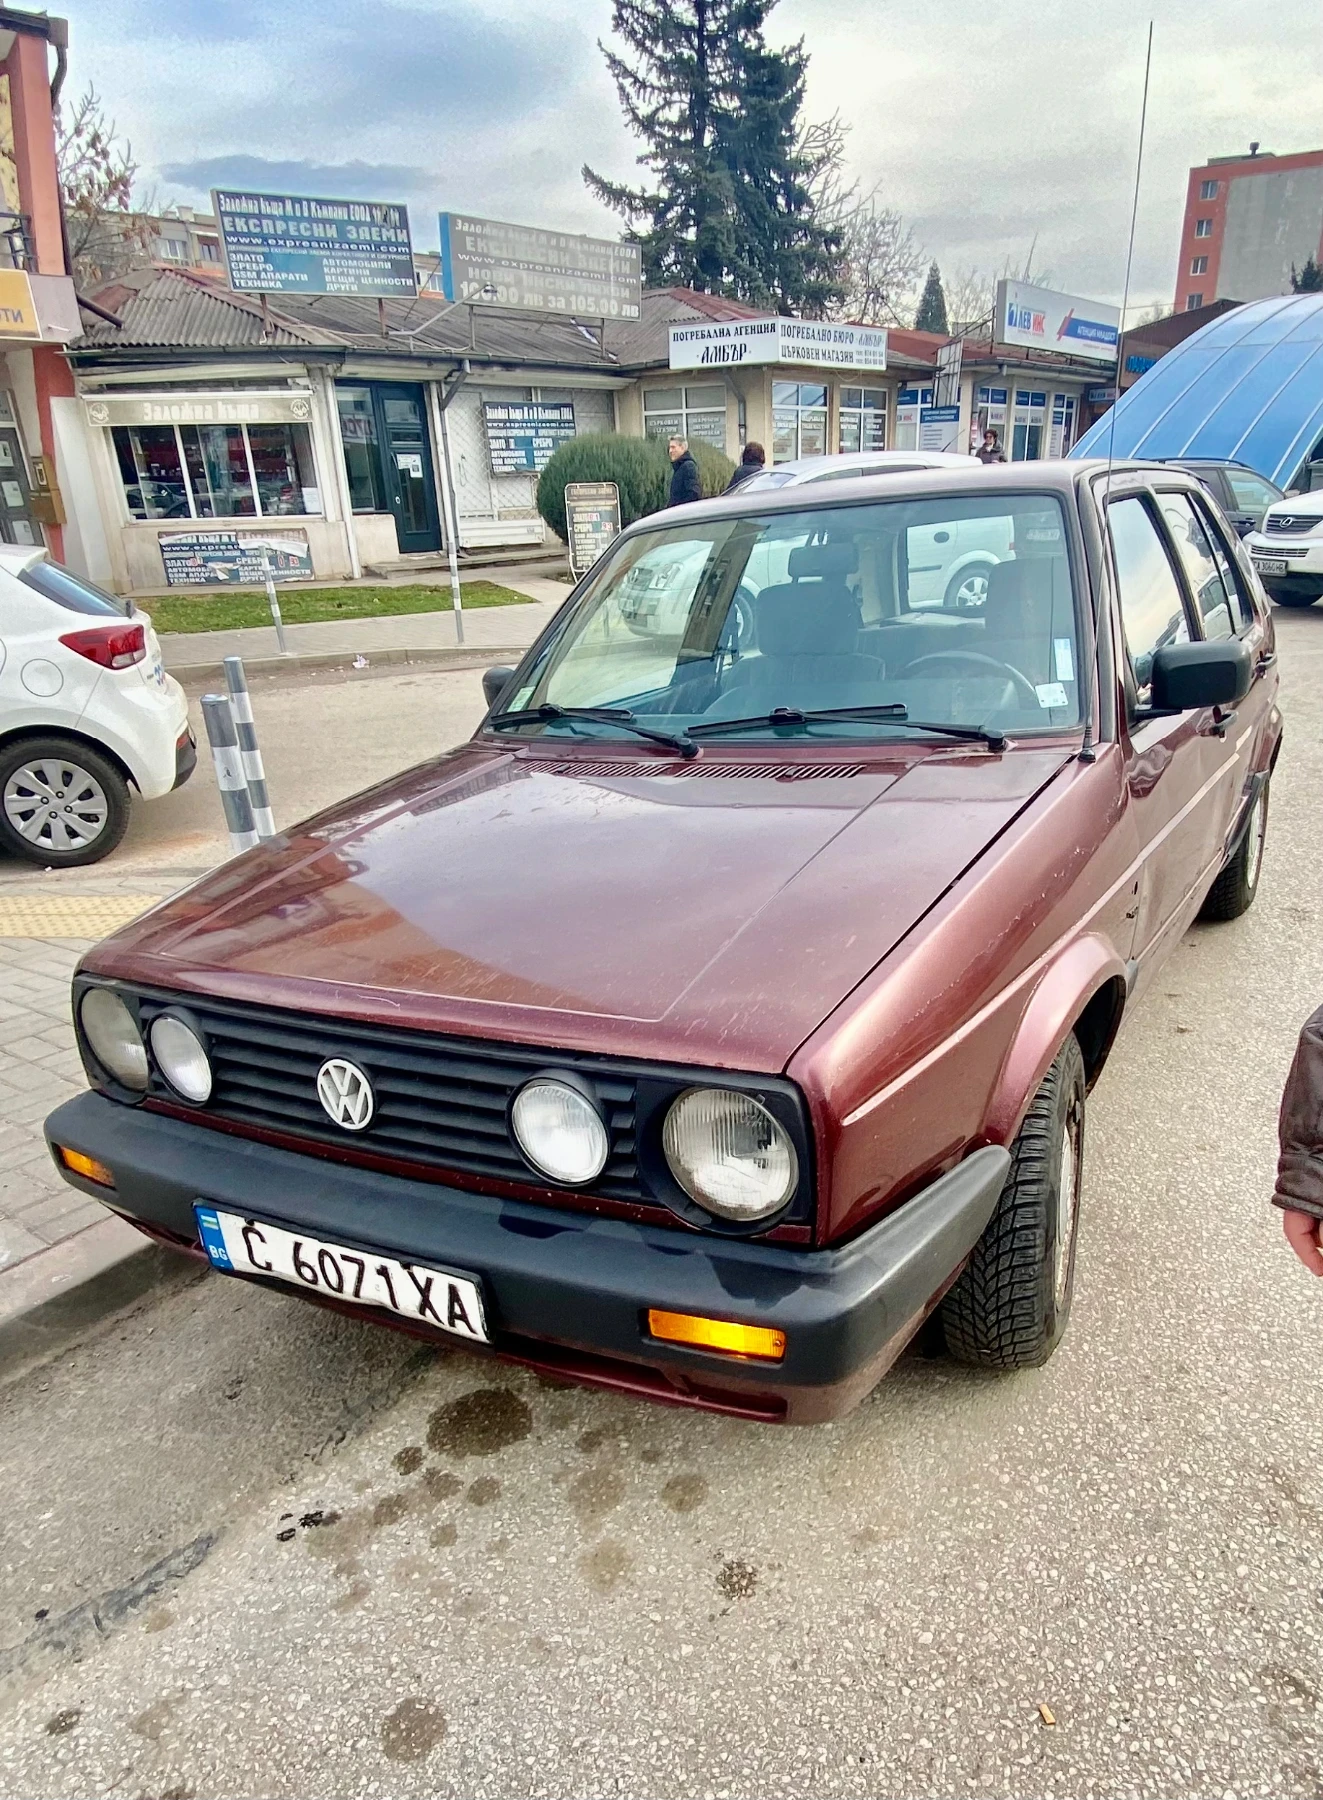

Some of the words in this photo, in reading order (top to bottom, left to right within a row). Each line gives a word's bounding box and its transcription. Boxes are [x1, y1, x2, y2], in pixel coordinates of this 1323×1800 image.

[220, 194, 259, 214] Заложна
[223, 216, 338, 238] ЕКСПРЕСНИ
[346, 225, 409, 242] ЗАЕМИ
[226, 235, 409, 253] www.expresnizaemi.com
[230, 253, 264, 262] ЗЛАТО
[231, 262, 273, 271] СРЕБРО
[322, 258, 392, 269] АВТОМОБИЛИ
[232, 271, 257, 279] GSM
[260, 271, 309, 281] АПАРАТИ
[324, 267, 370, 276] КАРТИНИ
[457, 253, 637, 284] www.expresnizaemi.com
[234, 279, 283, 288] ТЕХНИКА
[326, 283, 358, 292] ДРУГИ
[361, 276, 413, 286] ЦЕННОСТИ
[547, 295, 566, 309] за
[570, 294, 619, 315] 105.00
[0, 307, 24, 324] ТИ
[1018, 309, 1032, 330] ЛЕВ
[1032, 312, 1046, 333] ИНС
[673, 327, 731, 342] ПОГРЕБАЛНА
[734, 322, 776, 337] АГЕНЦИЯ
[780, 324, 831, 341] ПОГРЕБАЛНО
[833, 330, 854, 344] БЮРО
[781, 345, 820, 361] ЦЪРКОВЕН
[821, 349, 854, 363] МАГАЗИН
[143, 402, 213, 421] Заложна
[208, 1244, 229, 1261] BG
[242, 1225, 273, 1272] C
